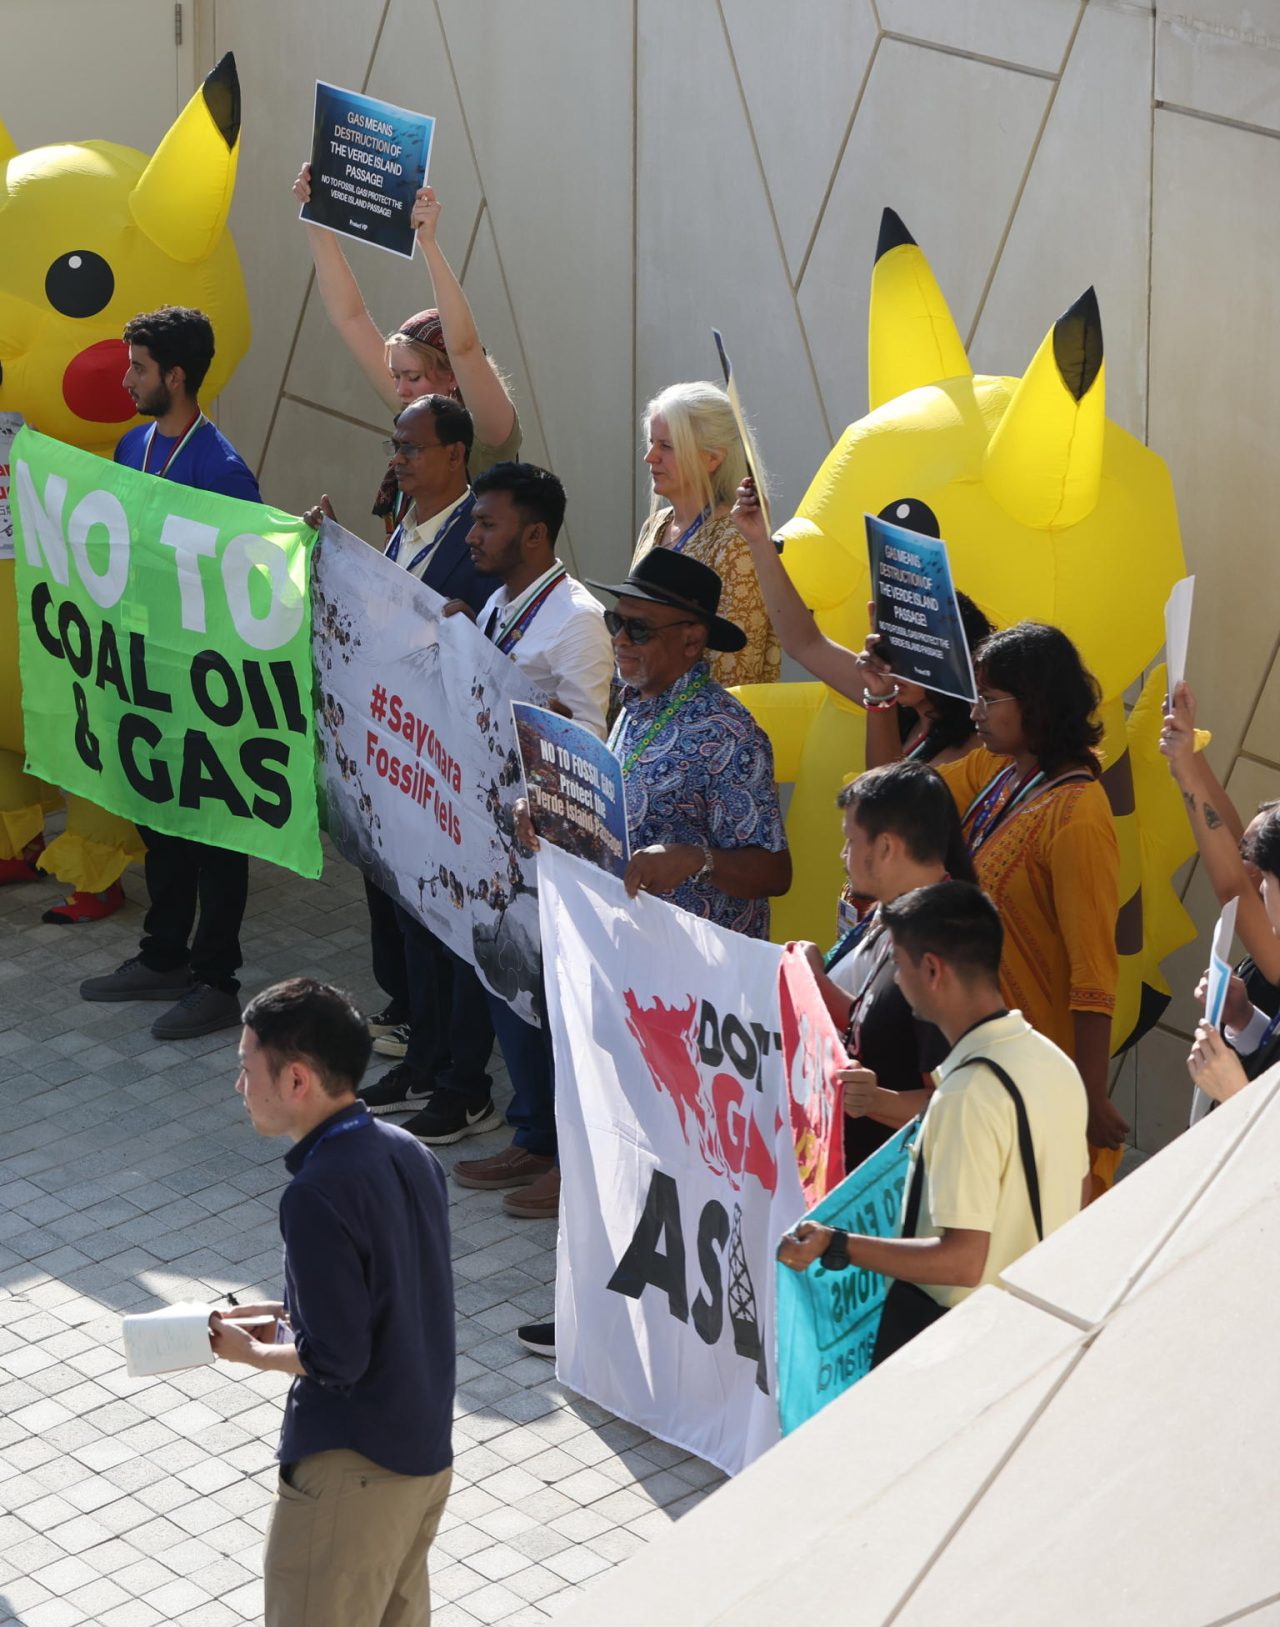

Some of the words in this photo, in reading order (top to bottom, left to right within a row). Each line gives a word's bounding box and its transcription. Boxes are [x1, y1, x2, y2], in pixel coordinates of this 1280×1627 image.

[334, 125, 390, 154] DESTRUCTION
[390, 144, 402, 158] OF
[347, 111, 364, 127] GAS
[365, 117, 393, 136] MEANS
[330, 140, 347, 157] THE
[347, 147, 374, 166] VERDE
[374, 156, 403, 176] ISLAND
[345, 164, 384, 188] PASSAGE!
[16, 458, 131, 608] NO
[160, 514, 305, 651] TO
[31, 581, 173, 713] COAL
[72, 681, 103, 774] &
[118, 712, 293, 829] GAS
[370, 684, 462, 794] #Sayonara
[540, 738, 556, 764] NO
[556, 746, 570, 771] TO
[571, 753, 600, 790] FOSSIL
[366, 730, 462, 845] FossilFuels
[535, 786, 565, 817] Verde
[560, 774, 594, 809] Protect
